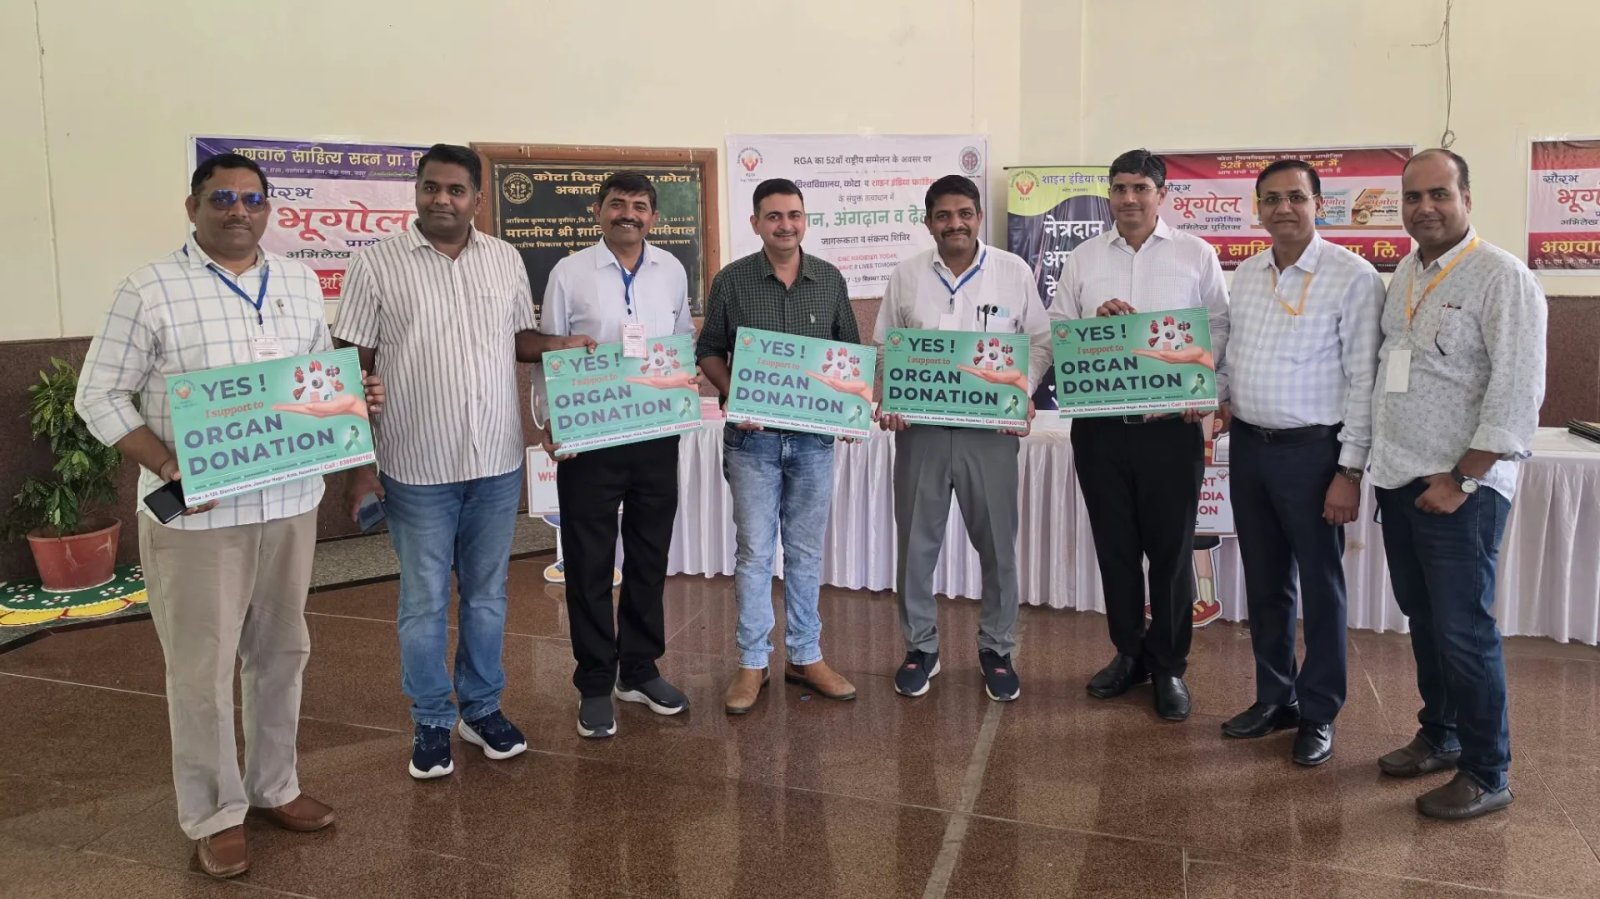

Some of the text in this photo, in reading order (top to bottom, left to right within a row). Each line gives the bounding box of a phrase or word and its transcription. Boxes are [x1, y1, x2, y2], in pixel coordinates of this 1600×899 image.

[292, 146, 343, 165] साहित्य
[348, 152, 382, 166] सदन
[386, 154, 406, 166] प्रा.
[794, 156, 812, 165] RGA
[815, 156, 824, 164] का
[845, 154, 864, 165] राष्ट्रीय
[866, 154, 890, 164] सम्मेलन
[892, 154, 899, 163] के
[923, 155, 932, 163] पर
[533, 171, 568, 182] कोटा
[844, 178, 861, 187] कोटा
[1042, 175, 1066, 185] शाइन
[1069, 172, 1094, 185] इंडिया
[1173, 191, 1242, 219] भूगोल
[277, 201, 416, 242] भूगोल
[894, 209, 904, 223] व
[1560, 218, 1598, 226] अभिलेख
[506, 226, 553, 237] माननीय
[558, 225, 573, 237] श्री
[1044, 214, 1105, 239] नेत्रदान
[868, 234, 889, 243] संकल्प
[891, 232, 911, 242] शिविर
[286, 249, 350, 259] अभिलेख
[1373, 240, 1400, 257] लि.
[1540, 240, 1600, 254] अग्रवा
[1060, 356, 1138, 375] ORGAN
[738, 368, 809, 390] ORGAN
[889, 368, 961, 385] ORGAN
[1063, 372, 1182, 395] DONATION
[554, 385, 632, 409] ORGAN
[736, 386, 844, 414] DONATION
[889, 386, 998, 406] DONATION
[211, 402, 252, 418] support
[253, 401, 264, 411] to
[557, 398, 672, 430] DONATION
[183, 413, 283, 449] ORGAN
[188, 427, 335, 476] DONATION
